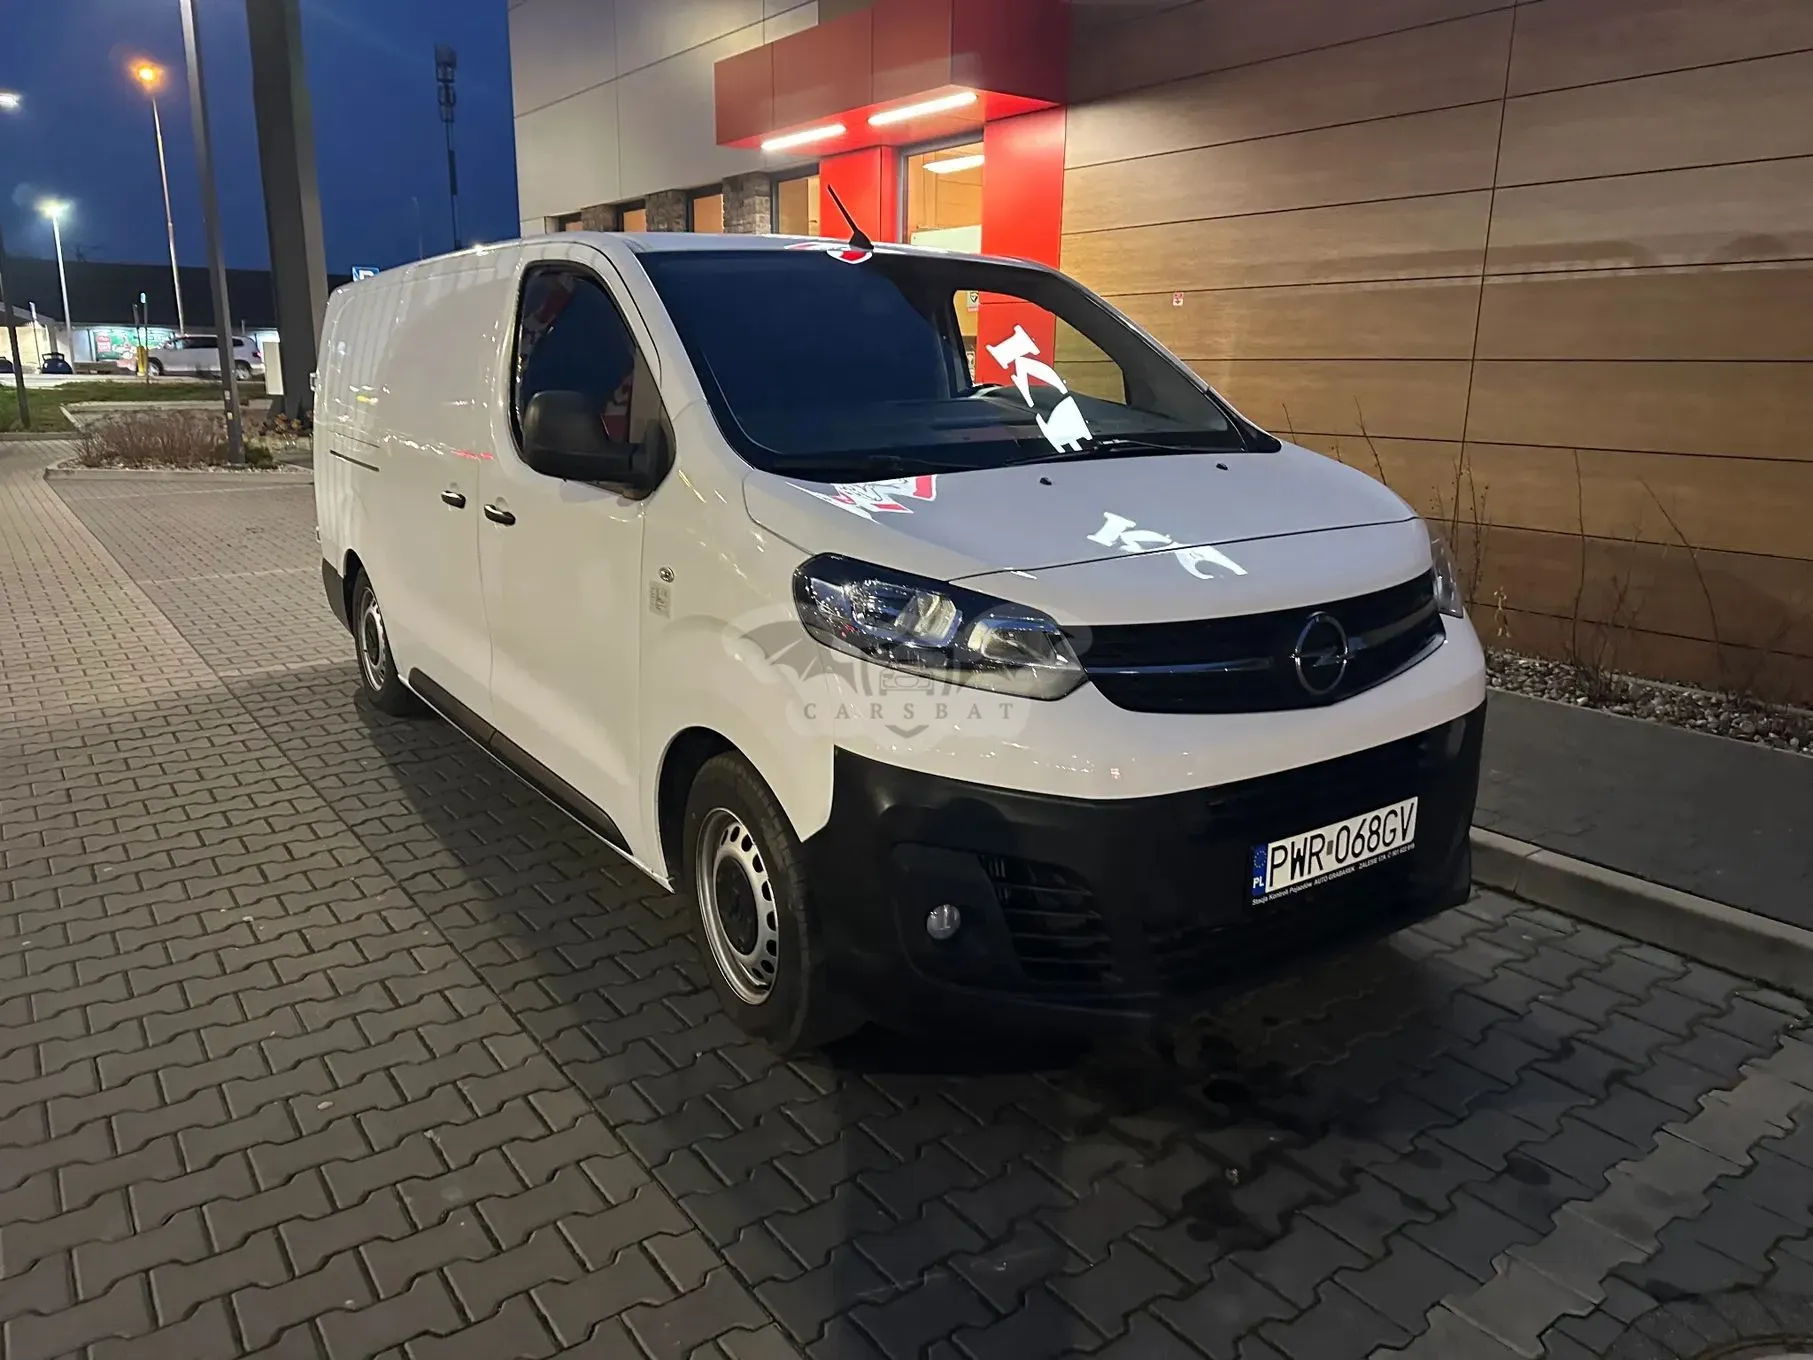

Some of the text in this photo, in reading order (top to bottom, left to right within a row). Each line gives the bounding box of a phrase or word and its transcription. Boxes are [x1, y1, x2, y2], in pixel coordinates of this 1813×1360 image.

[1269, 802, 1415, 887] PWR 068GV
[1253, 876, 1264, 889] PL
